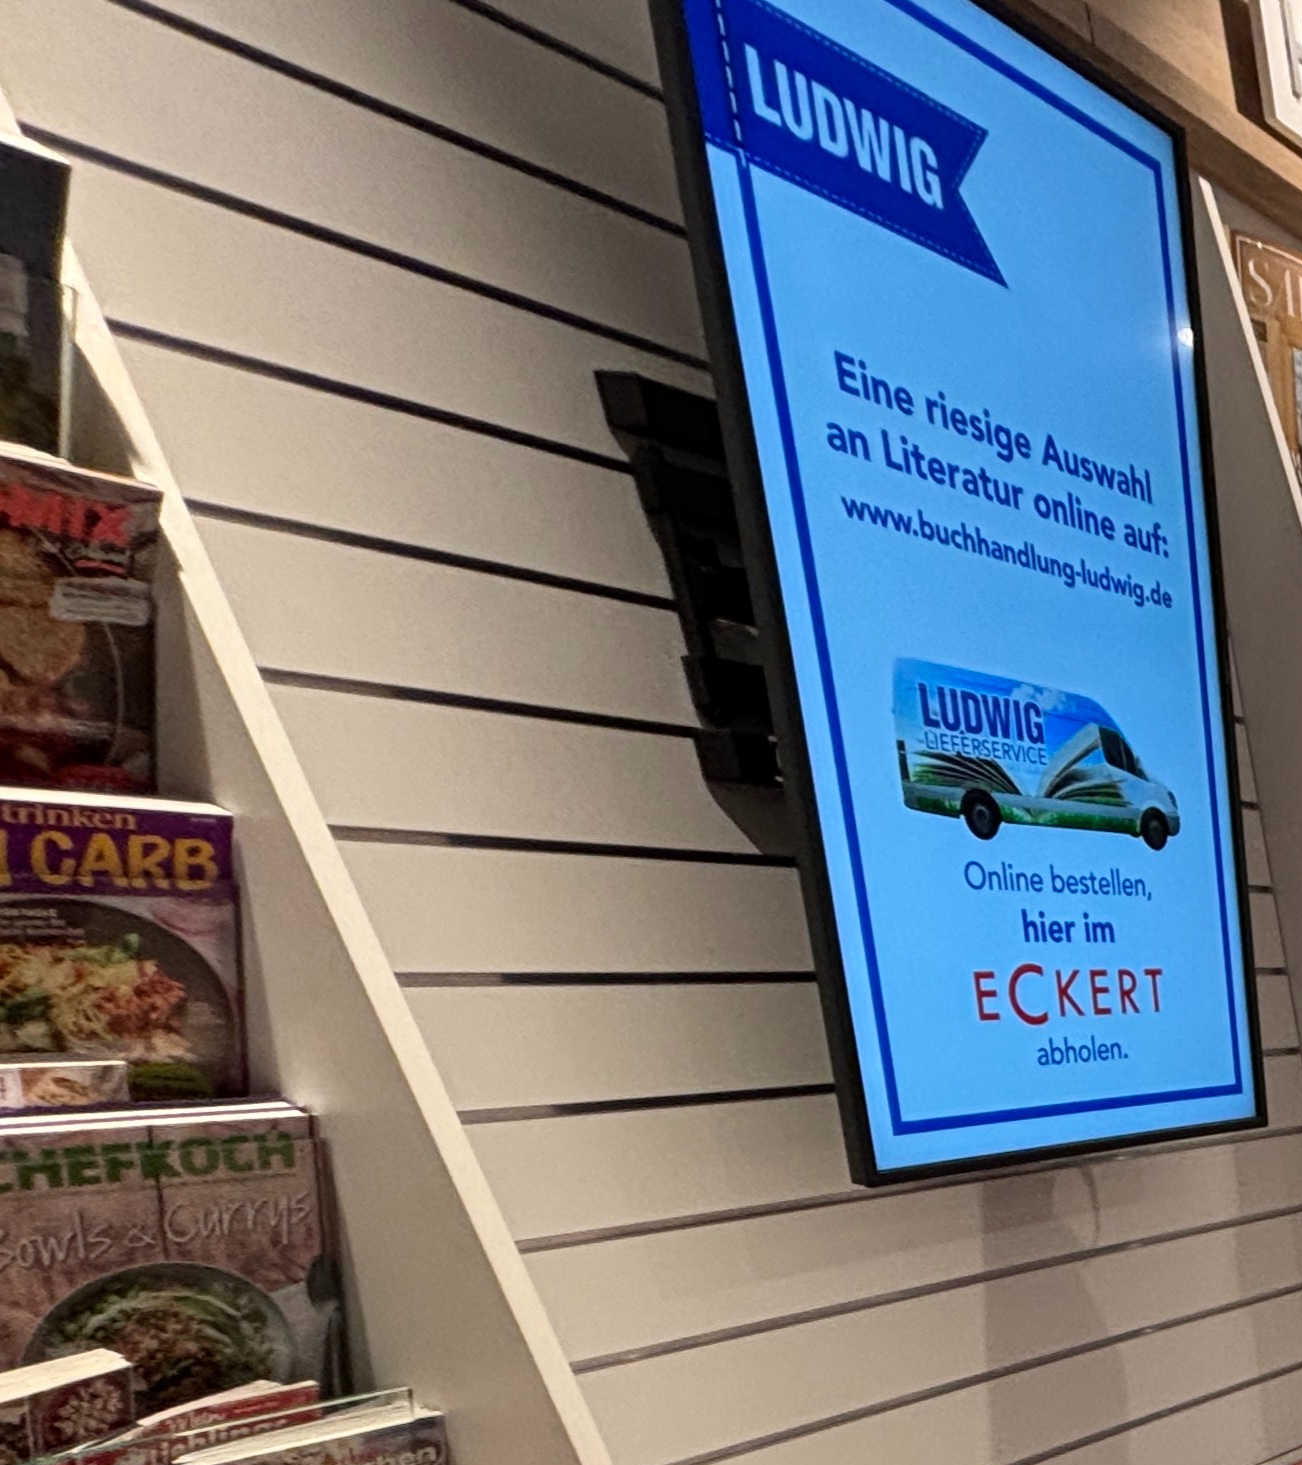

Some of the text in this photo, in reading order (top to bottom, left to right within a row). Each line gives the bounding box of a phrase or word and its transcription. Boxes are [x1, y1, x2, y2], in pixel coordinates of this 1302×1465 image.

[742, 43, 945, 211] LUDWIG
[833, 350, 1154, 505] Eine riesige Auswahl
[827, 419, 1170, 559] an Literatur online auf:
[840, 493, 1173, 610] www.buchhandlung-ludwig.de
[917, 682, 1045, 745] LUDWIG
[923, 730, 1048, 766] LIEFERSERVICE
[30, 828, 220, 891] CARB
[964, 860, 1152, 901] Online bestellen,
[1021, 909, 1115, 943] hier im
[972, 963, 1164, 1025] ECKERT
[1037, 1035, 1129, 1066] abholen.
